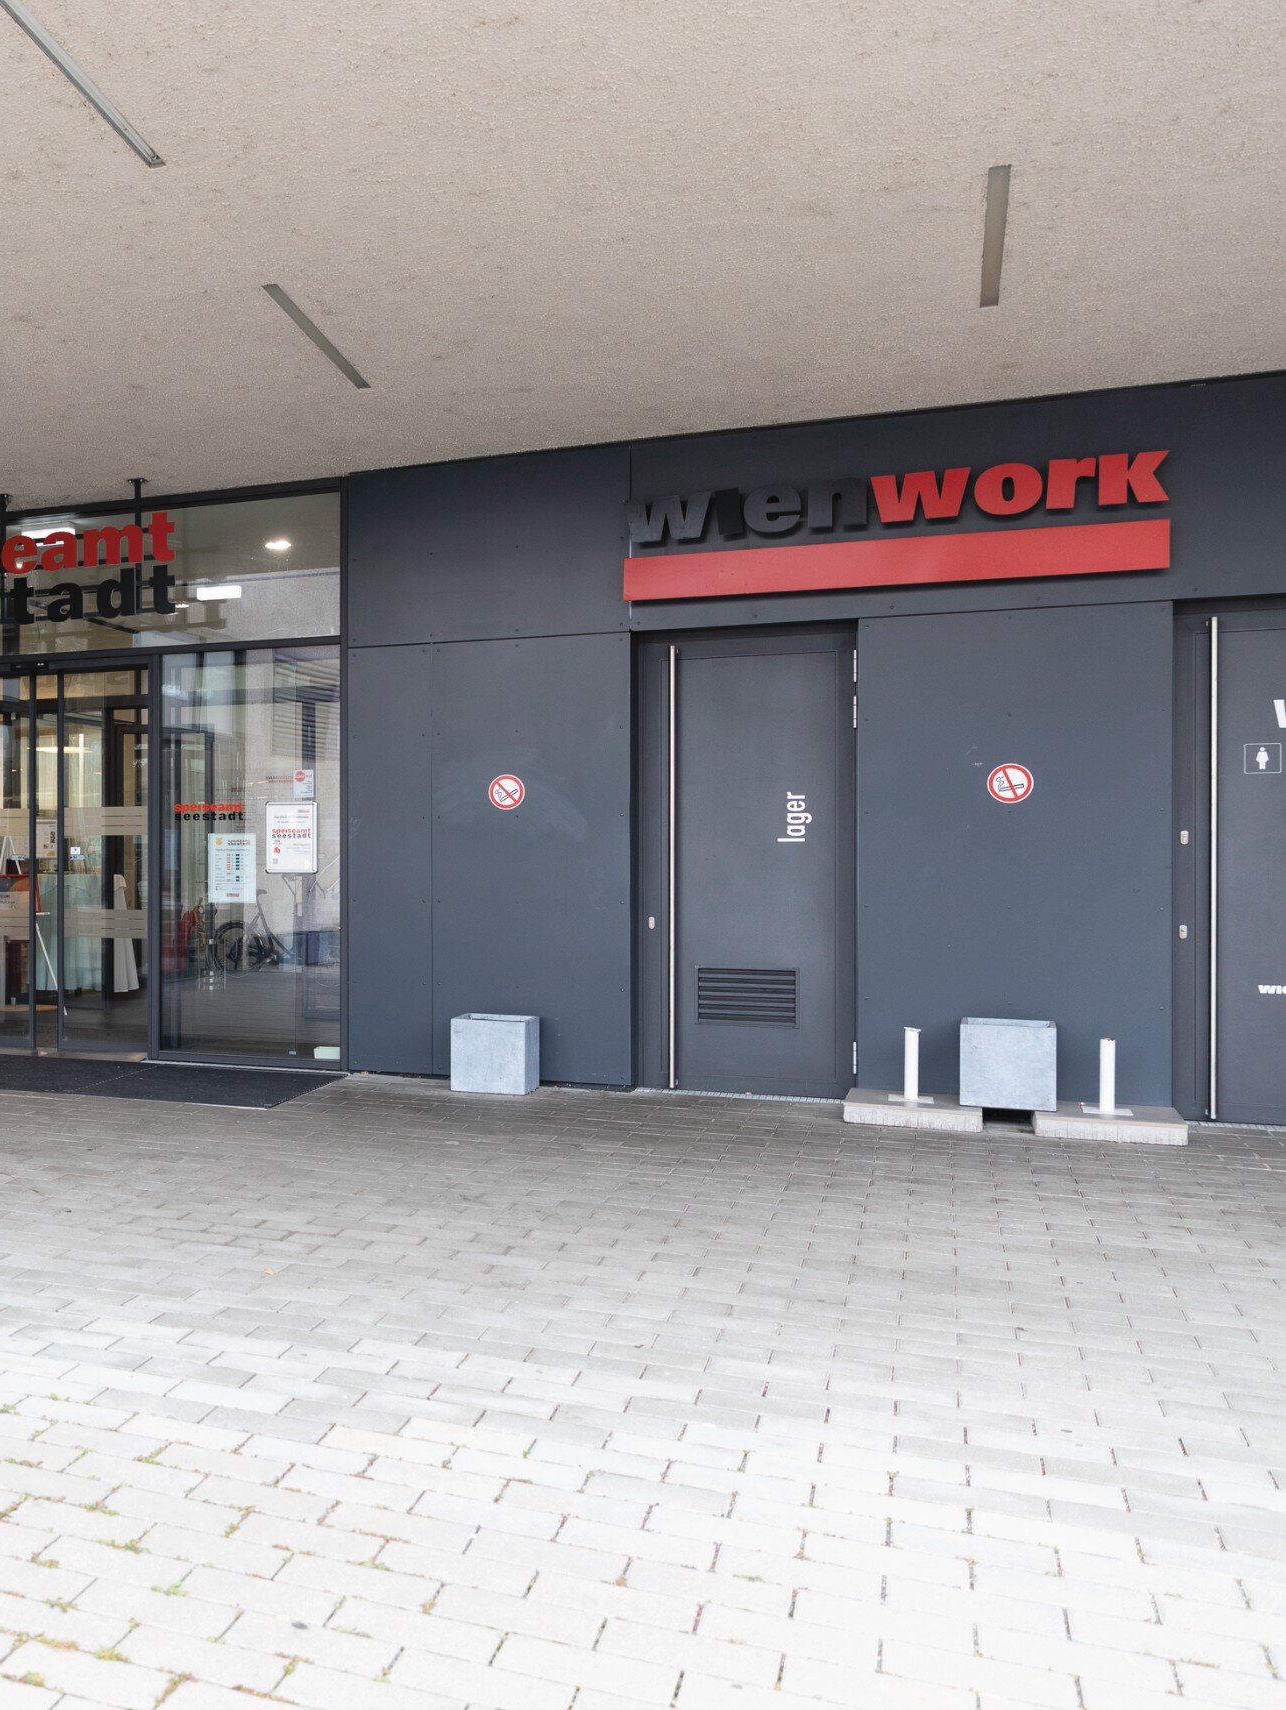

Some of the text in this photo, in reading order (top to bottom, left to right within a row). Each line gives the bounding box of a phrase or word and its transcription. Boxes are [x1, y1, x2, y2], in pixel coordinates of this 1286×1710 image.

[624, 450, 1170, 544] wienwork
[173, 801, 243, 813] speiseamt
[174, 811, 244, 821] seestadt
[777, 791, 813, 843] lager
